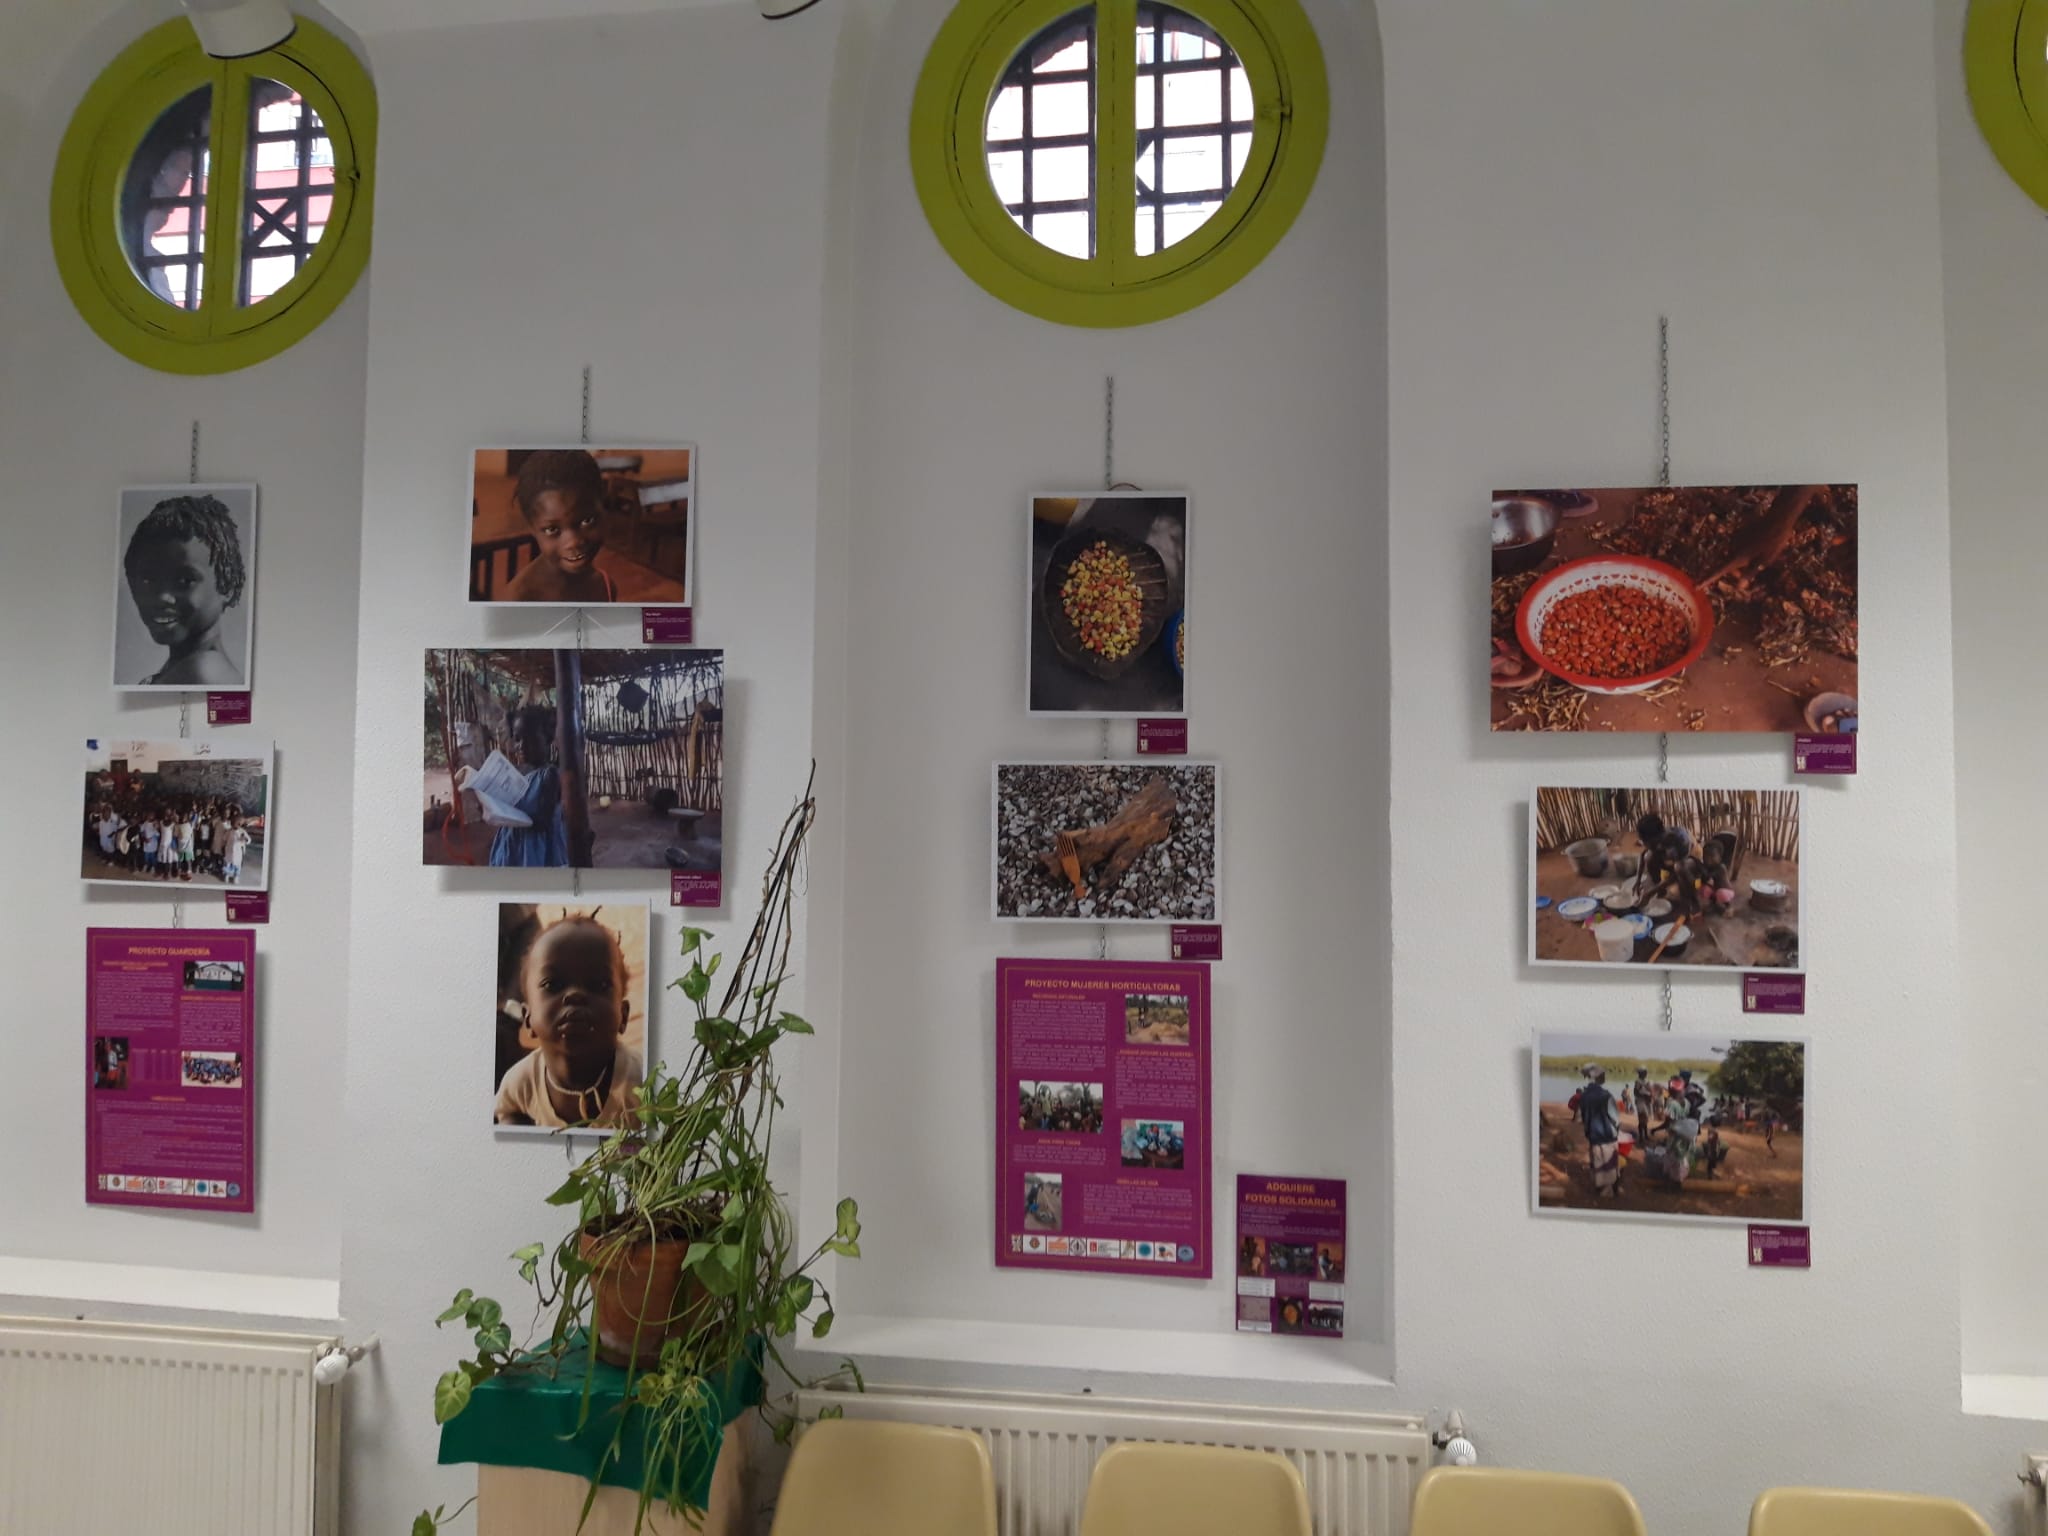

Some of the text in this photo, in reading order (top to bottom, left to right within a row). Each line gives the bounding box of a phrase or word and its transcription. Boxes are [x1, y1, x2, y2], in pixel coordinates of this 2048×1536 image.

[1024, 979, 1181, 992] PROYECTO MUJERES HORTICULTORAS
[1266, 1182, 1316, 1193] ADQUIERE
[1245, 1193, 1337, 1208] FOTOS SOLIDARIAS
